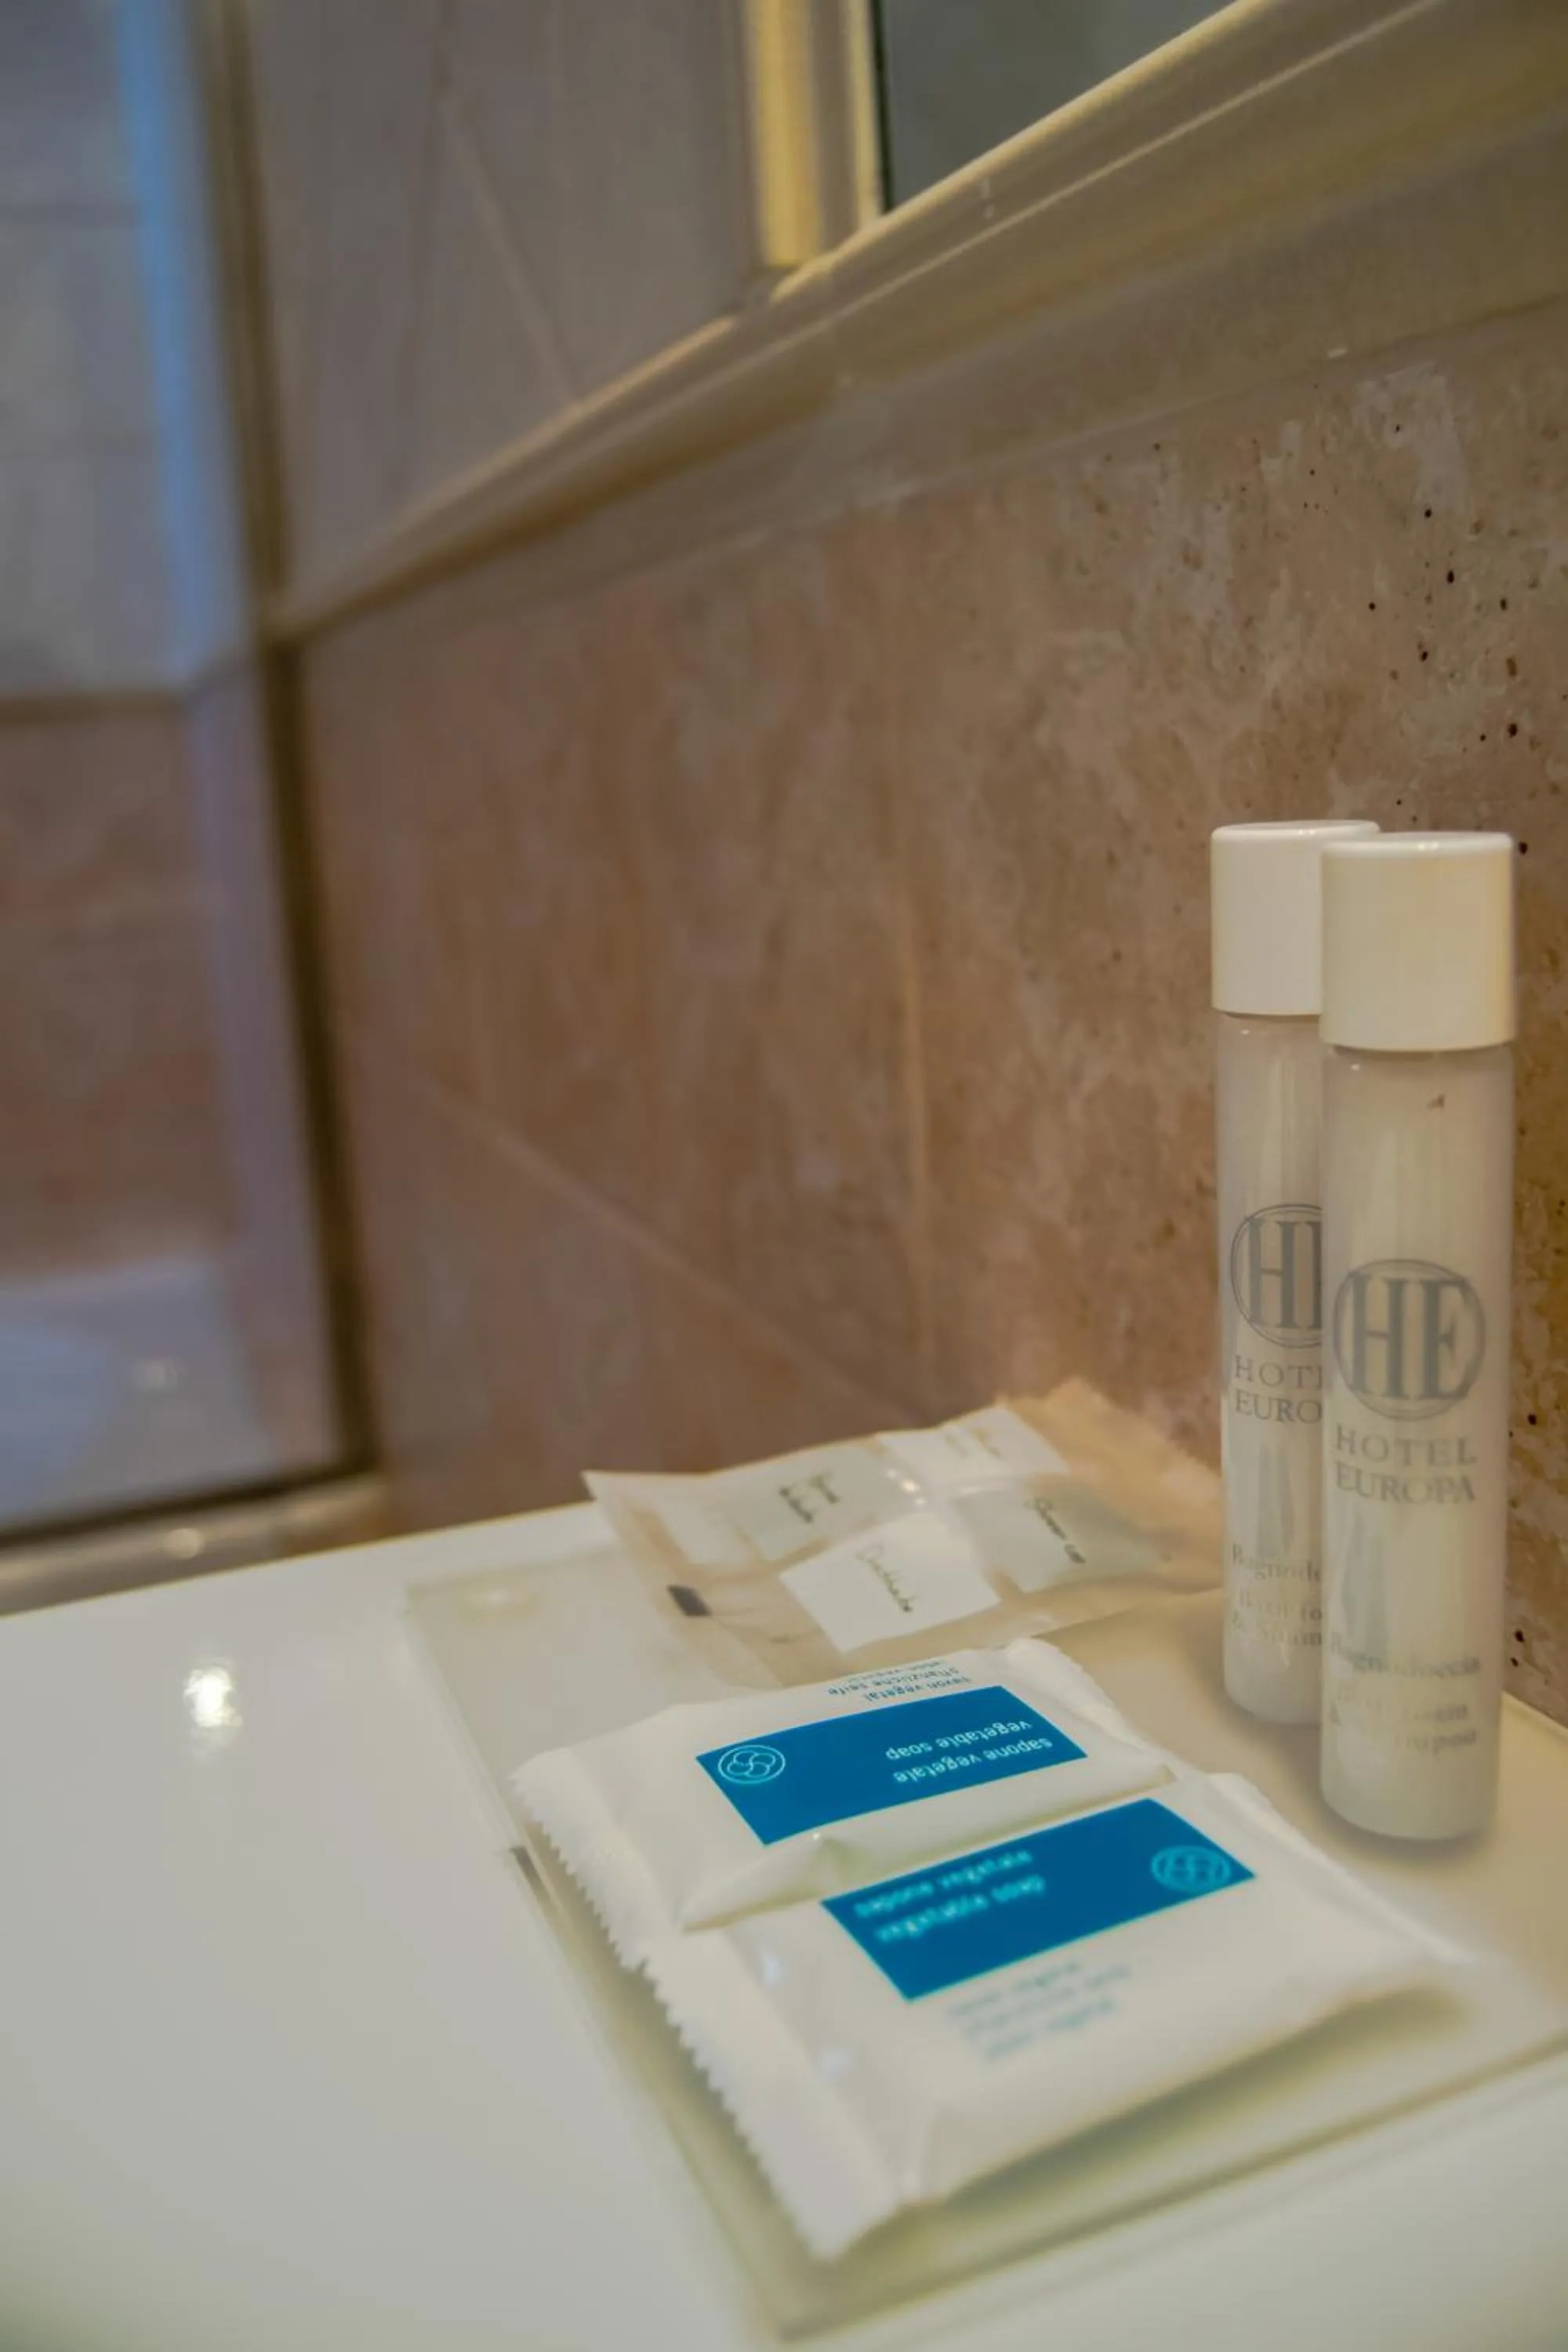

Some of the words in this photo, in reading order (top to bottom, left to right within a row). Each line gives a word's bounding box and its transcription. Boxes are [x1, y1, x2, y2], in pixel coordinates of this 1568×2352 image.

[1347, 1270, 1472, 1402] HE
[1234, 1354, 1322, 1390] HOT
[1234, 1388, 1322, 1425] EURO
[1336, 1423, 1478, 1468] HOTEL
[1335, 1463, 1477, 1505] EUROPA
[884, 1741, 933, 1760] soap
[935, 1720, 1033, 1748] vegetable
[982, 1737, 1053, 1761] sapone
[892, 1754, 982, 1783] vegetale
